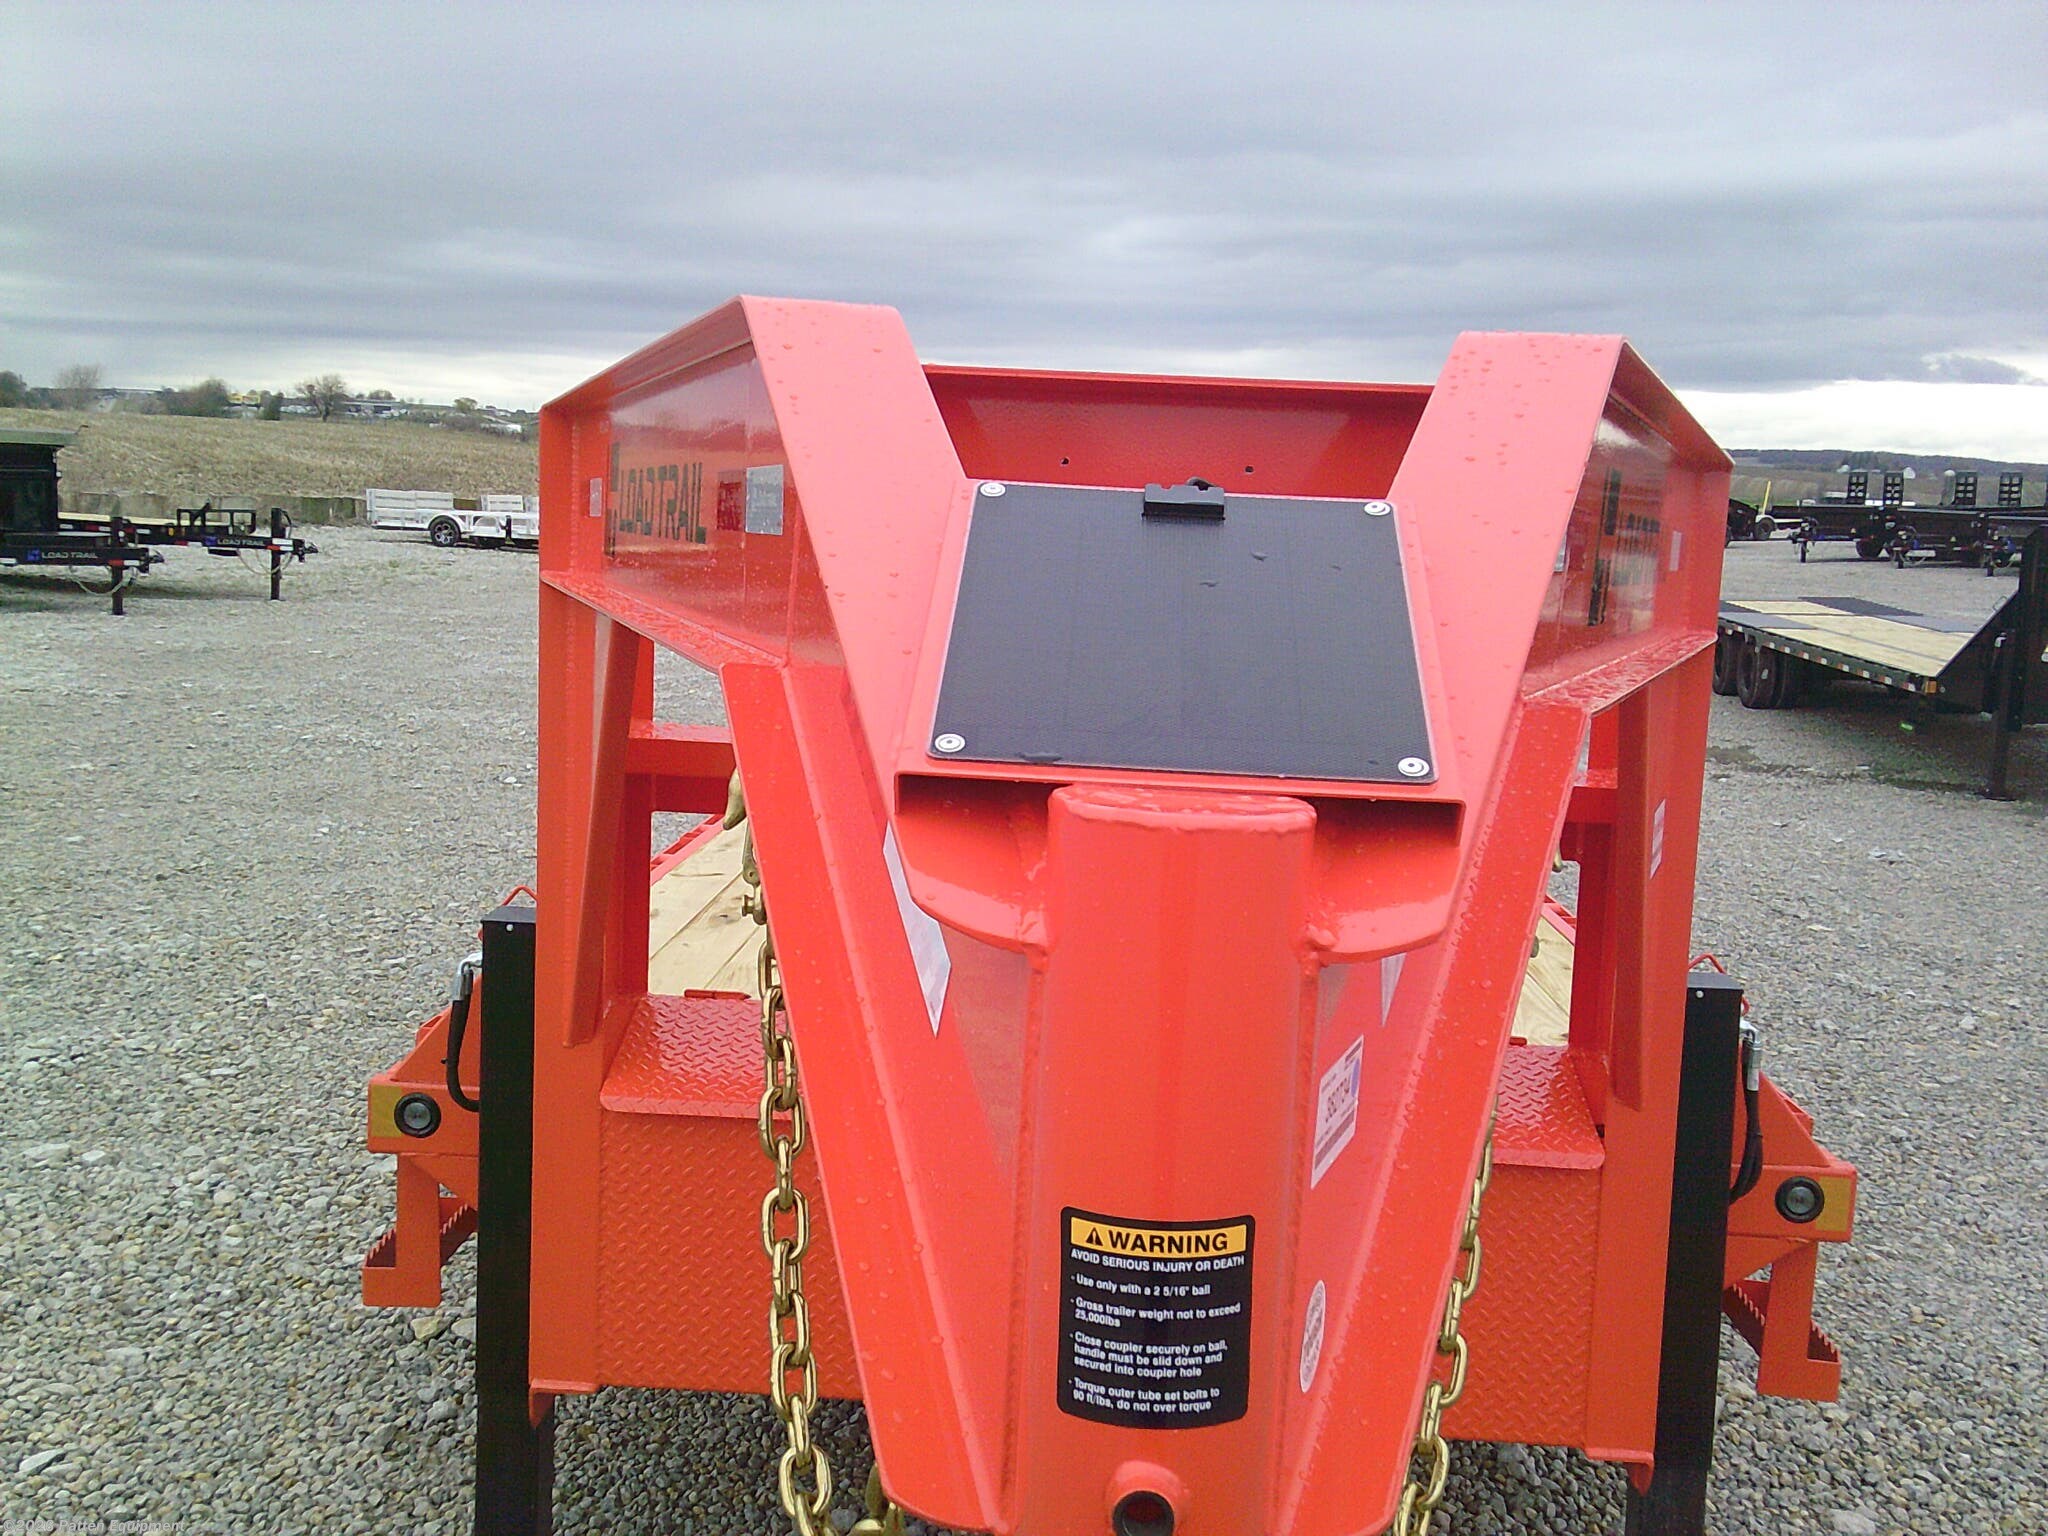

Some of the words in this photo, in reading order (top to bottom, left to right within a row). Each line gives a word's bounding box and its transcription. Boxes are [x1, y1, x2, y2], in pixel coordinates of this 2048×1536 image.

[41, 551, 69, 559] LOAD
[70, 551, 98, 559] TRAIL
[1108, 1229, 1228, 1253] WARNING
[1071, 1248, 1100, 1264] AVOID
[1102, 1255, 1150, 1271] SERIOUS
[1152, 1261, 1193, 1273] INJURY
[1195, 1260, 1211, 1272] OR
[1213, 1255, 1245, 1270] DEATH
[1076, 1273, 1094, 1287] Use
[1096, 1279, 1117, 1294] only
[1120, 1283, 1141, 1295] with
[1144, 1286, 1151, 1296] a
[1153, 1286, 1160, 1296] 2
[1192, 1284, 1211, 1296] ball
[1075, 1296, 1104, 1313] Gross
[1106, 1304, 1136, 1317] trailer
[1139, 1308, 1174, 1322] weight
[1176, 1308, 1194, 1319] not
[1196, 1308, 1206, 1319] to
[1208, 1302, 1241, 1317] exceed
[1074, 1342, 1106, 1360] handle
[1108, 1352, 1134, 1364] must
[1136, 1355, 1150, 1365] be
[1152, 1355, 1172, 1366] slid
[1174, 1355, 1203, 1366] down
[1205, 1352, 1223, 1364] and
[1075, 1331, 1102, 1347] Close
[1104, 1340, 1143, 1354] coupler
[1146, 1344, 1190, 1356] securely
[1192, 1344, 1206, 1354] on
[1074, 1356, 1112, 1373] secured
[1114, 1363, 1135, 1376] into
[1137, 1366, 1177, 1380] coupler
[1180, 1366, 1202, 1378] hole
[1074, 1376, 1106, 1396] Torque
[1108, 1387, 1136, 1399] outer
[1138, 1389, 1161, 1401] tube
[1164, 1390, 1180, 1401] set
[1183, 1388, 1208, 1400] bolts
[1210, 1387, 1220, 1397] to
[1116, 1399, 1131, 1410] do
[1133, 1401, 1150, 1412] not
[1153, 1402, 1177, 1413] over
[1179, 1400, 1212, 1414] torque
